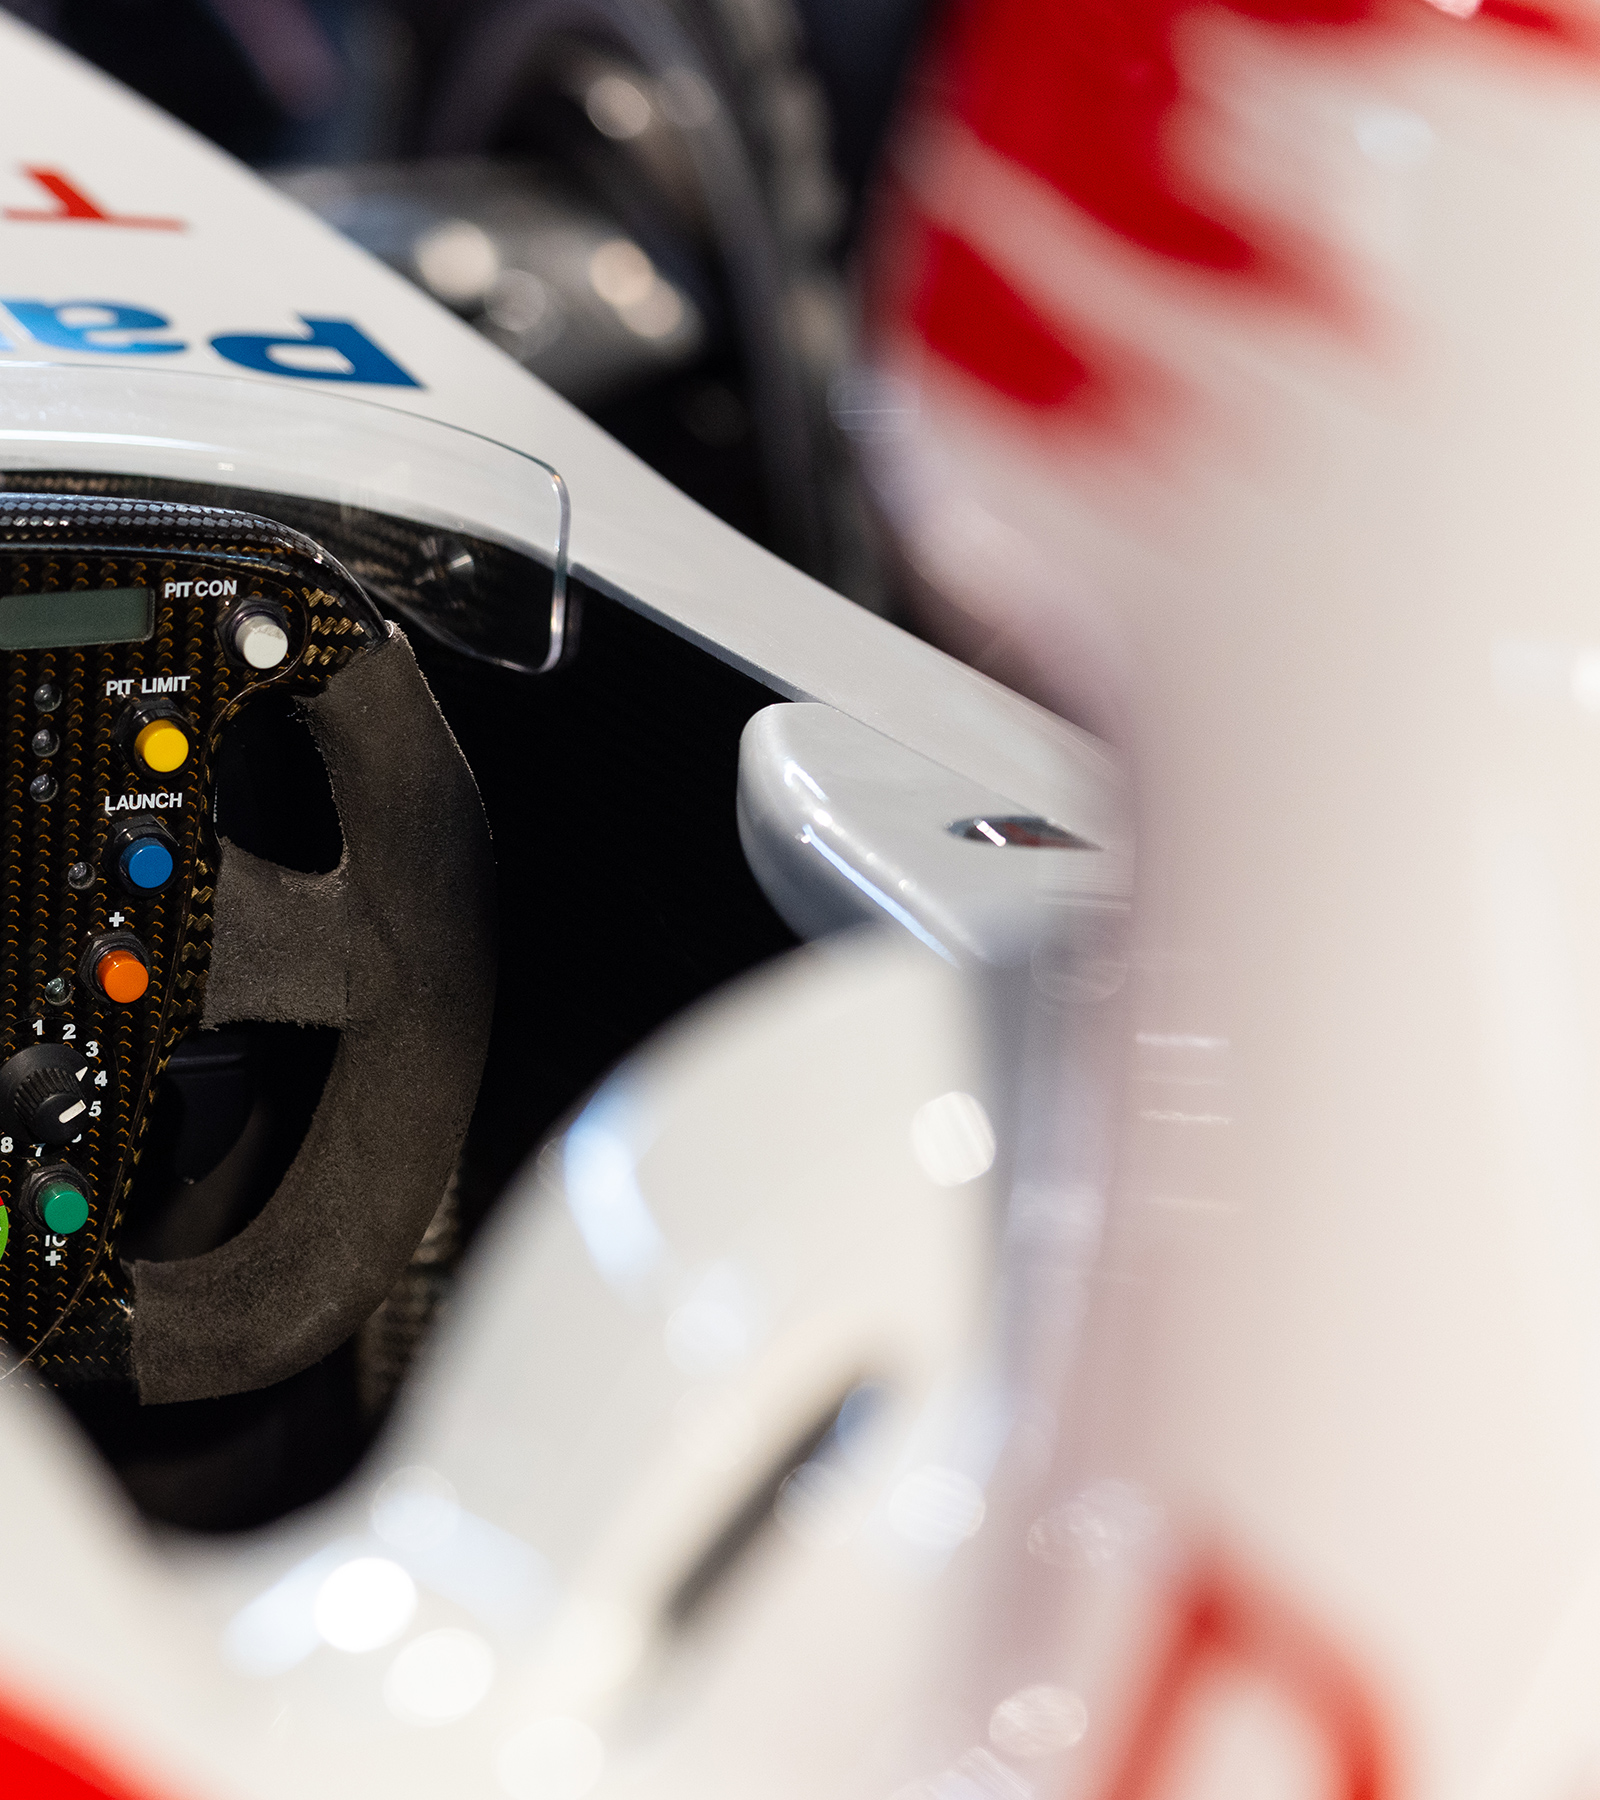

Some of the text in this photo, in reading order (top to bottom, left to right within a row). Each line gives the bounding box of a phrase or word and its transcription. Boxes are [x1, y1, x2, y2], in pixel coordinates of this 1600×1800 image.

[106, 676, 191, 696] PIT LIMIT
[104, 792, 183, 811] LAUNCH
[32, 1019, 43, 1036] 1
[62, 1023, 76, 1040] 2
[85, 1041, 99, 1057] 3
[94, 1070, 108, 1087] 4
[88, 1101, 102, 1118] 5
[0, 1137, 14, 1153] 8
